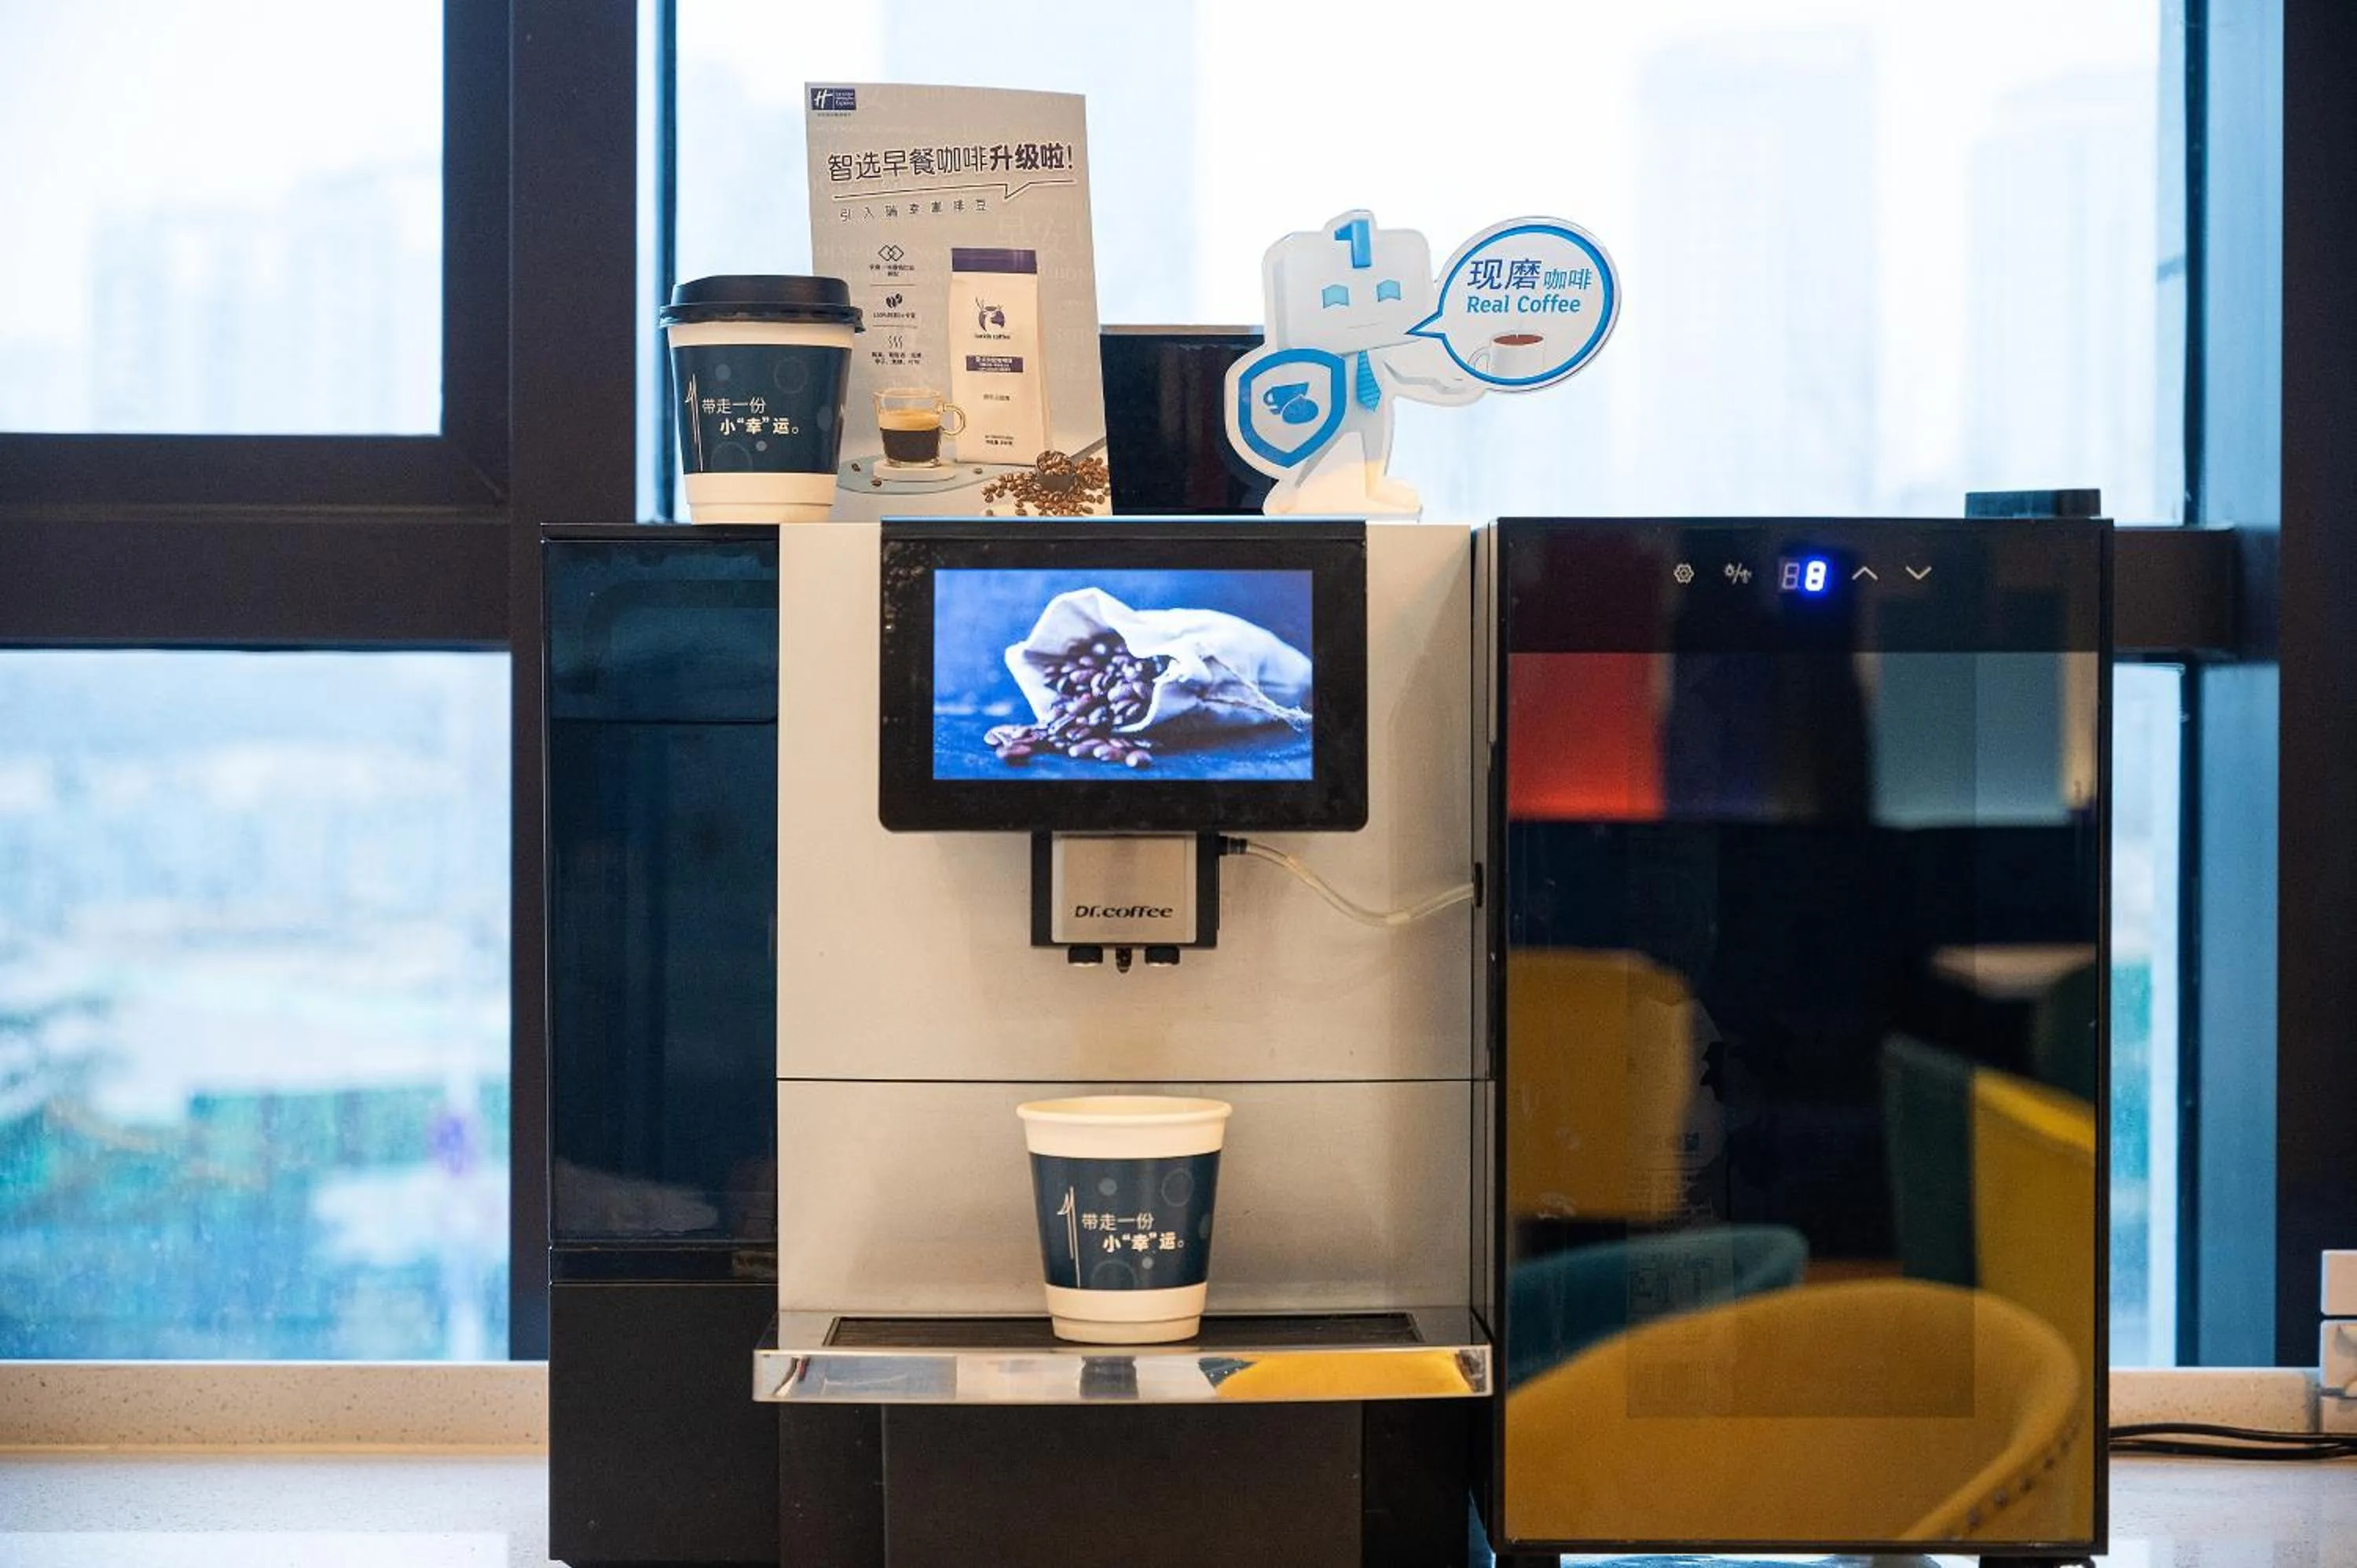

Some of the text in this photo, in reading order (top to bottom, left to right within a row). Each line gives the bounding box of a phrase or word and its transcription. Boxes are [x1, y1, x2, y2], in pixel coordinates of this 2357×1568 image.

[828, 143, 1073, 181] 智选早餐咖啡升级啦!
[1466, 295, 1581, 313] Real Coffee
[702, 397, 767, 414] 带走一份
[1074, 905, 1174, 918] Dr.coffee
[1081, 1212, 1154, 1231] 带走一份
